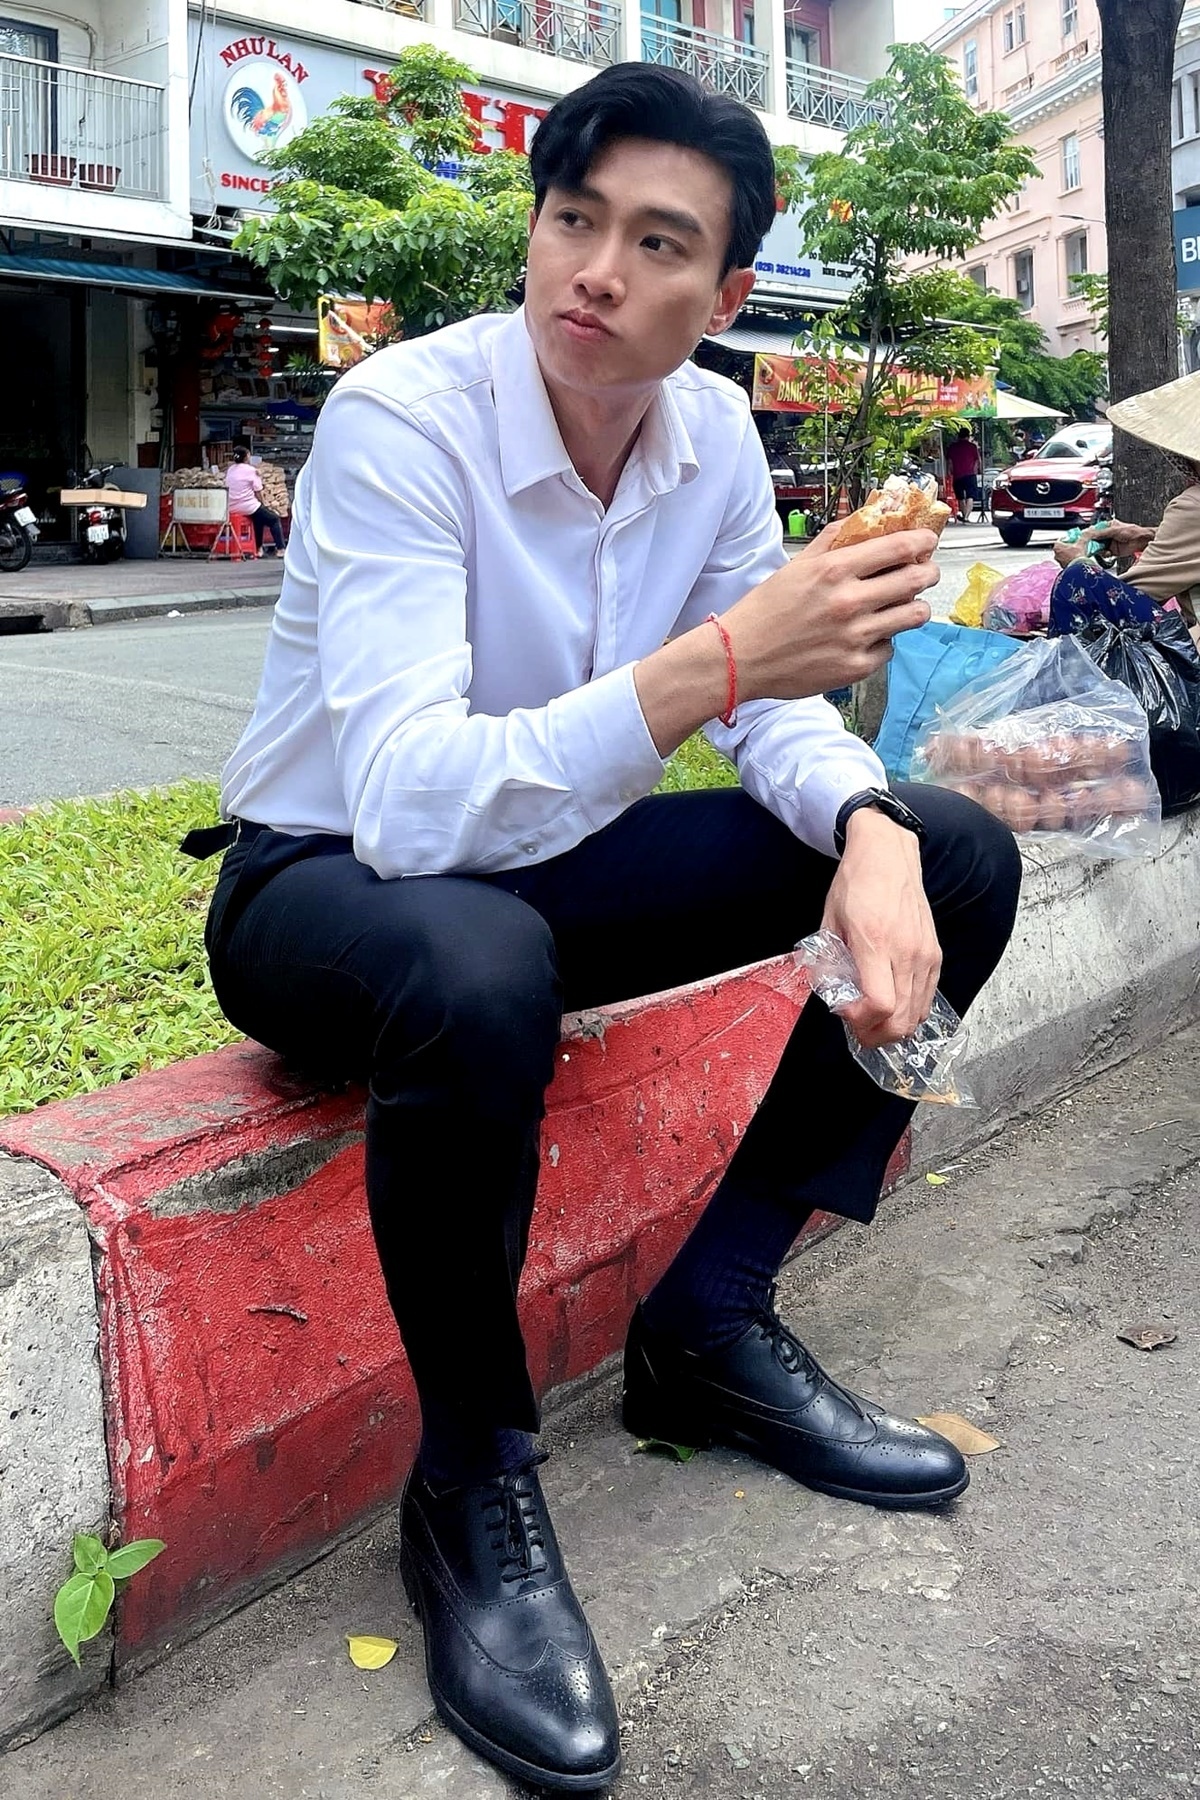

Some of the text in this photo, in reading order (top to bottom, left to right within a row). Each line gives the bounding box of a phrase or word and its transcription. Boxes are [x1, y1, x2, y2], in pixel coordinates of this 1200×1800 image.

[219, 36, 309, 84] NHƯ LAN
[221, 173, 270, 193] SINCE
